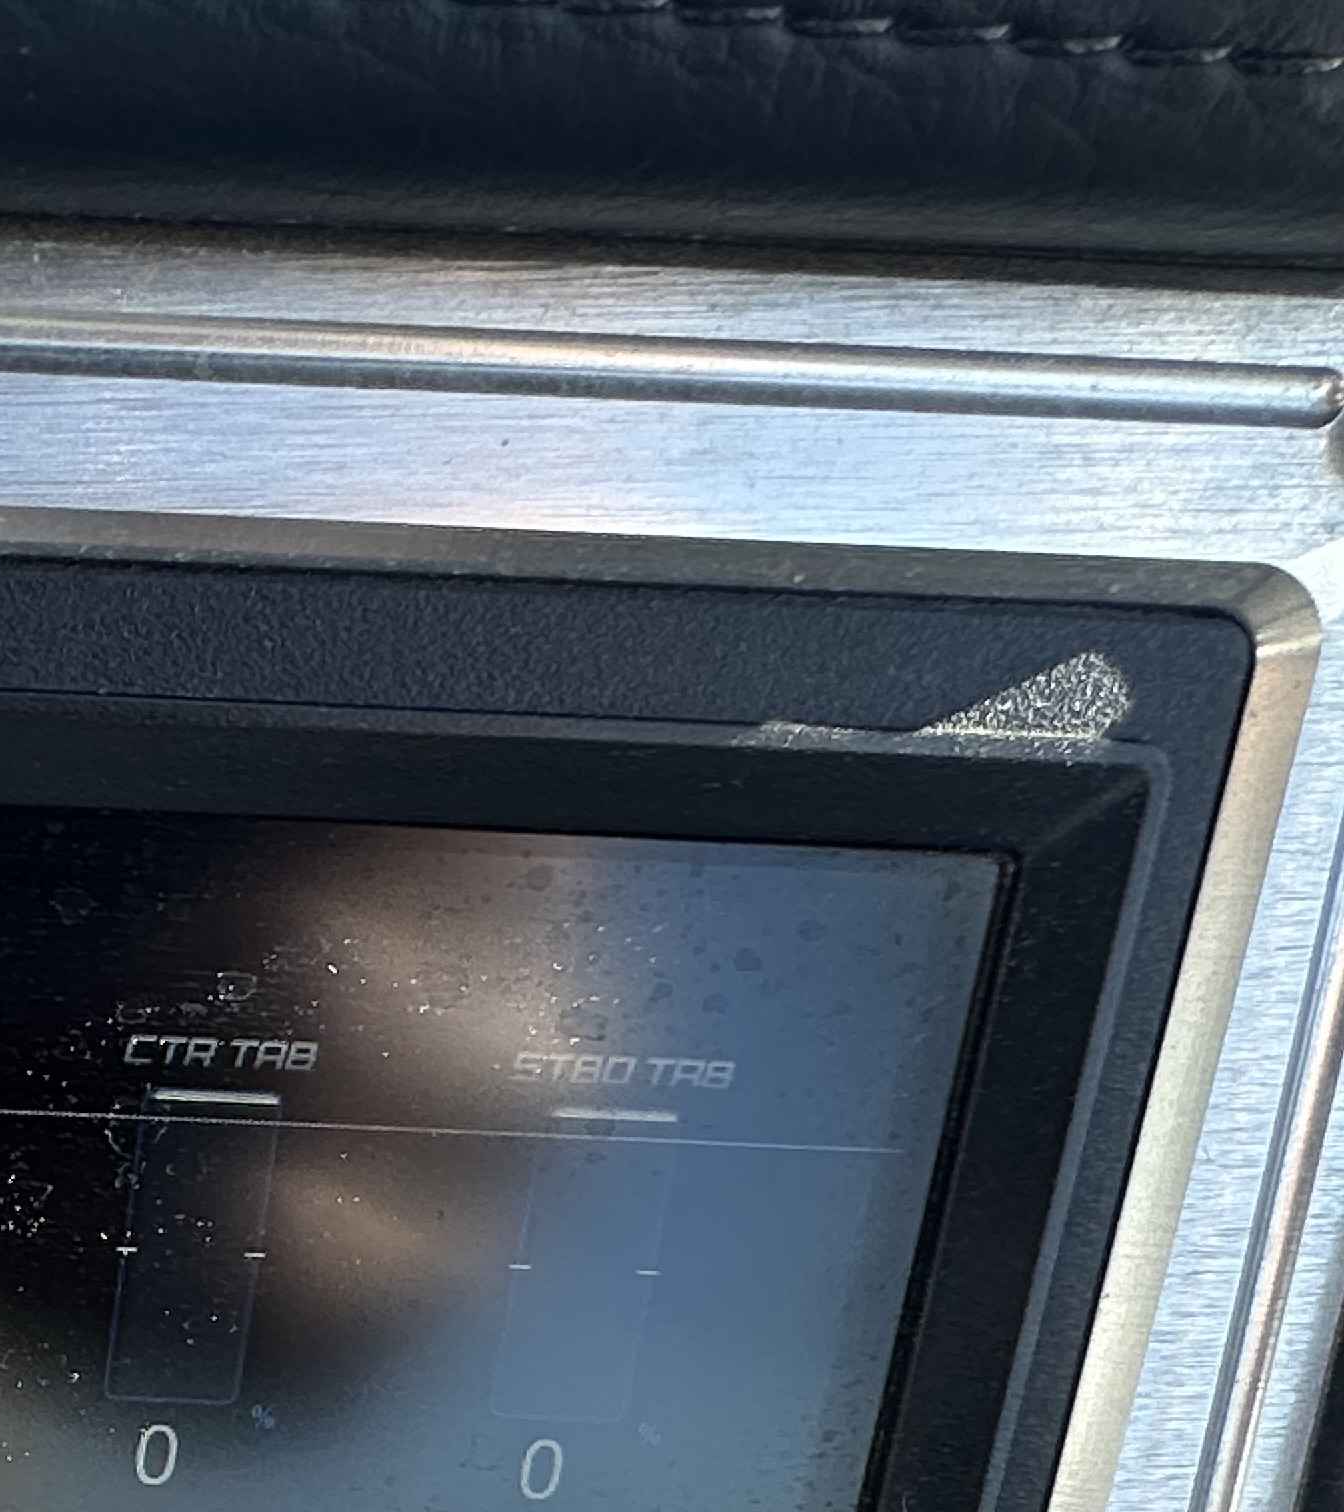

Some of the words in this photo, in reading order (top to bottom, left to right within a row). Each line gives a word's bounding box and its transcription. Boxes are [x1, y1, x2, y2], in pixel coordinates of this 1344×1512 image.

[124, 1034, 218, 1067] CTR
[229, 1038, 319, 1071] TAB
[510, 1052, 638, 1085] STBD
[646, 1056, 737, 1089] TAB
[136, 1424, 178, 1486] 0
[520, 1438, 562, 1500] 0
